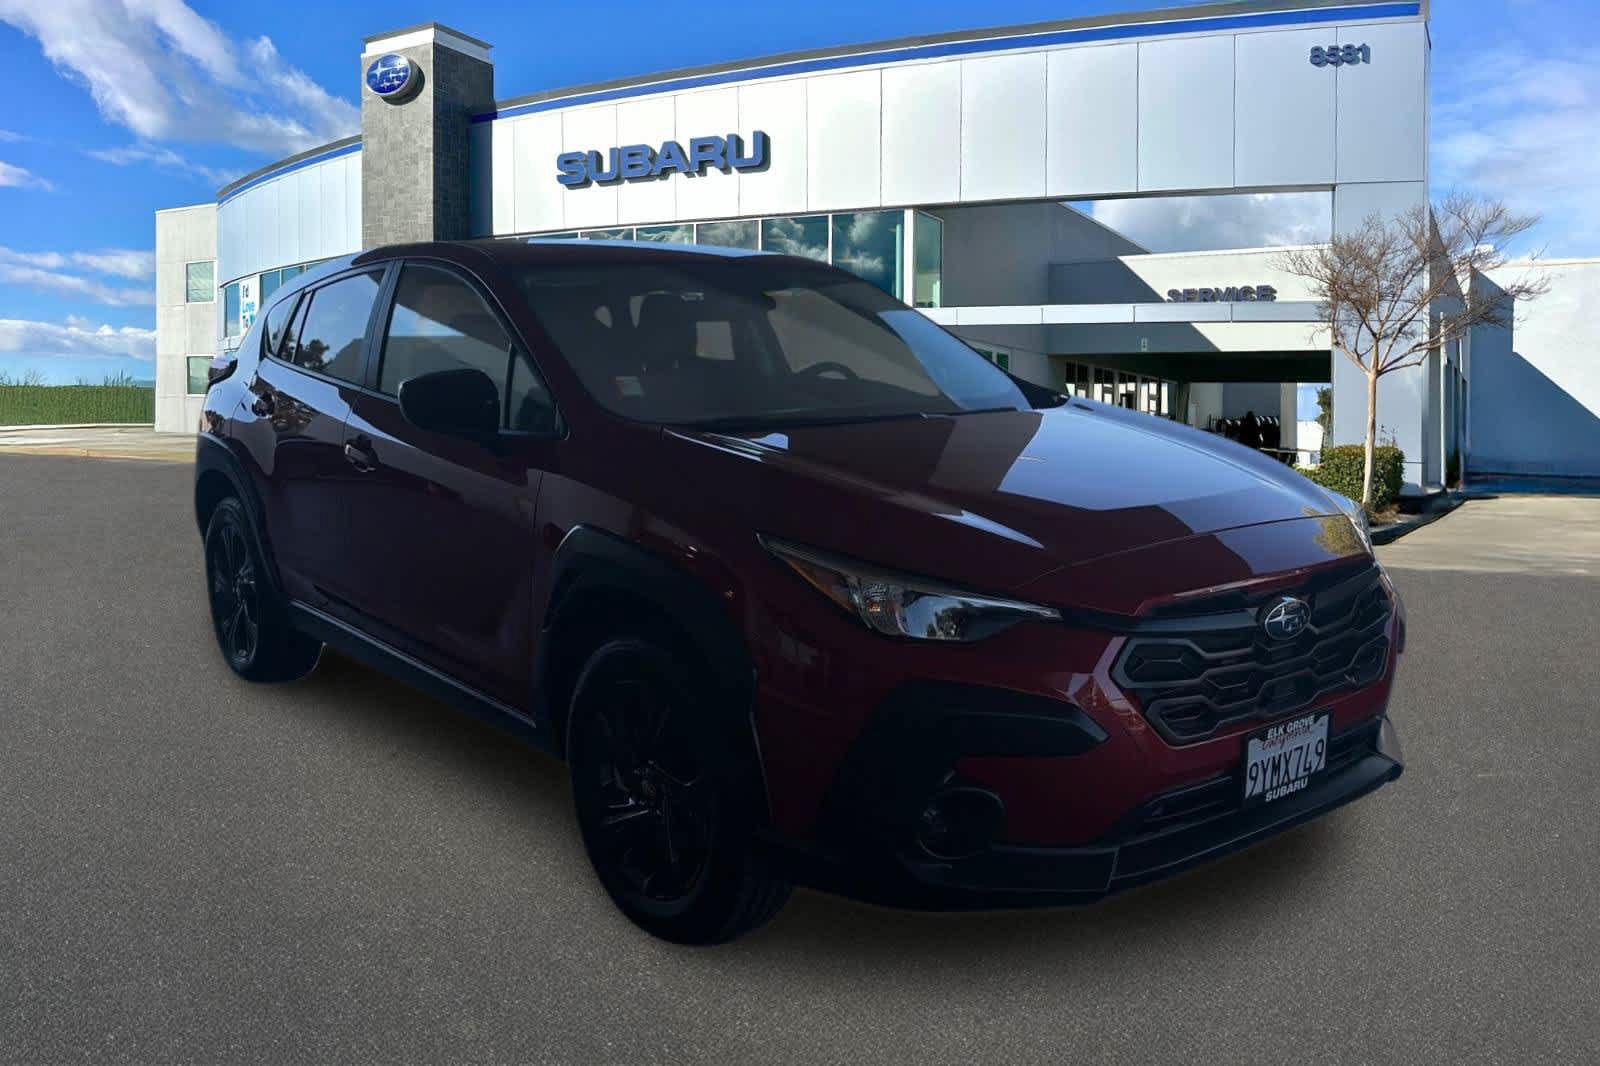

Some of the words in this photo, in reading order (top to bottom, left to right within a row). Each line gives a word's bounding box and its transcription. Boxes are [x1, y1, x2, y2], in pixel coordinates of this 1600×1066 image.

[556, 130, 769, 189] SUBARU
[1166, 284, 1277, 302] SERVICE
[1267, 726, 1285, 739] ELK
[1287, 715, 1316, 733] GROVE
[1248, 738, 1325, 797] 9YMX749
[1265, 777, 1309, 802] SUBARU
